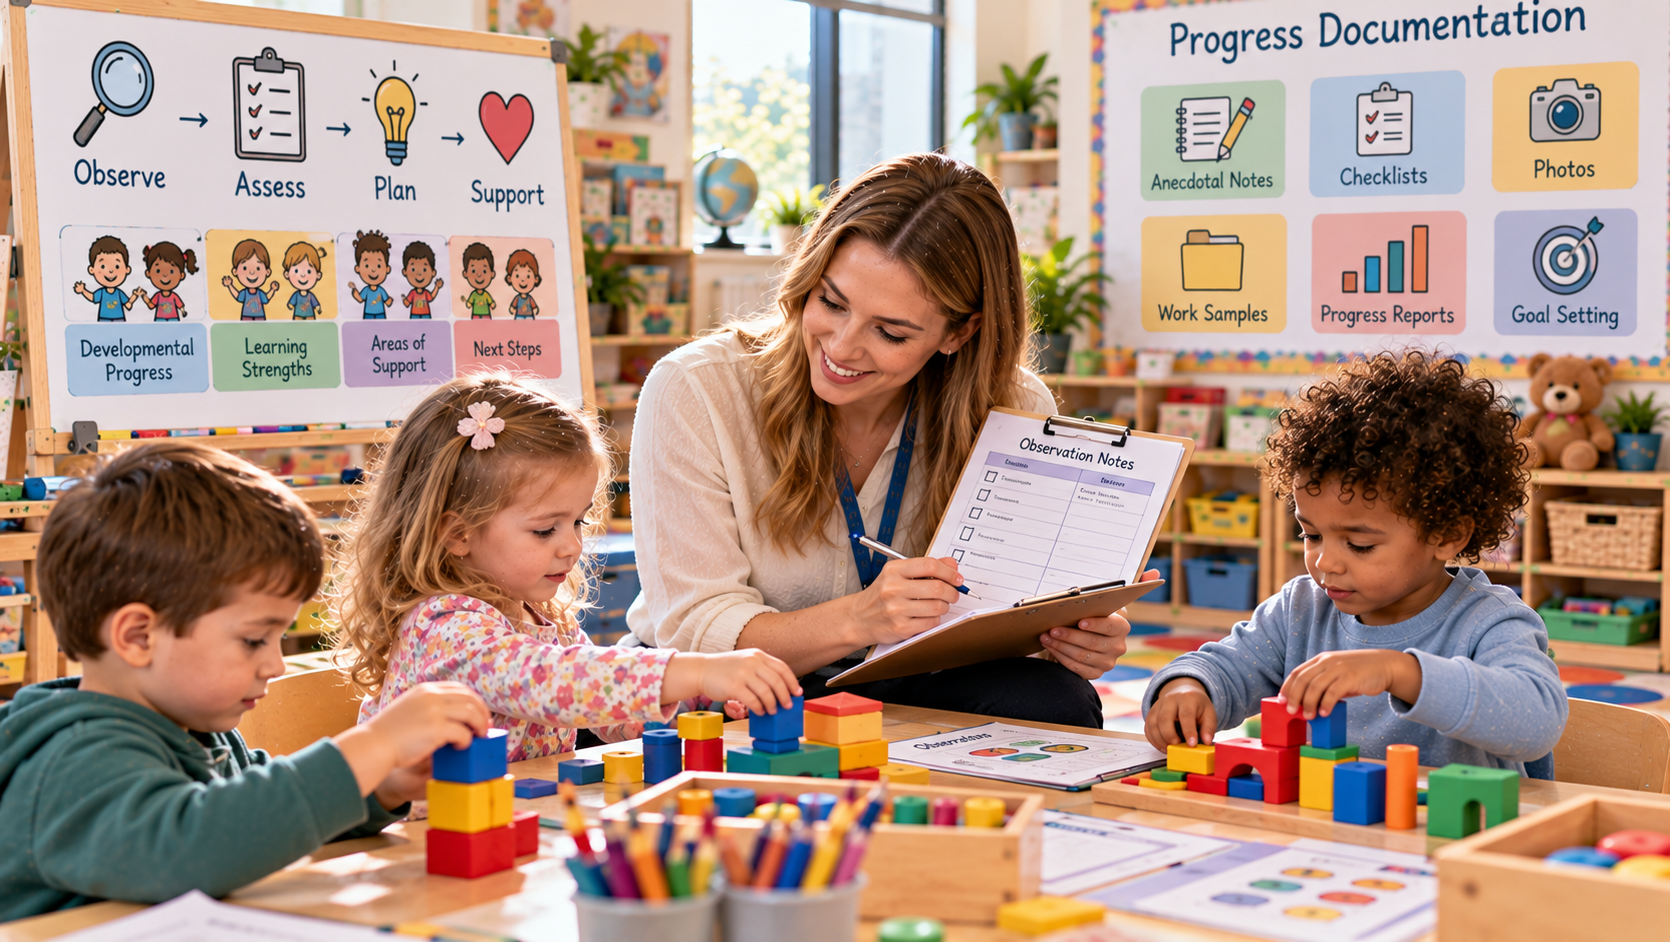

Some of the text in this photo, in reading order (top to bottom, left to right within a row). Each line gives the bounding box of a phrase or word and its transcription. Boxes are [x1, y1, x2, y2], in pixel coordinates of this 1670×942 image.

[1170, 0, 1586, 65] Progress Documentation
[73, 158, 166, 189] Observe
[1150, 170, 1274, 191] Anecdotal Notes
[1340, 165, 1428, 186] Checklists
[1534, 158, 1596, 179] Photos
[234, 170, 306, 199] Assess
[374, 175, 417, 201] Plan
[471, 179, 545, 213] Support
[1157, 303, 1268, 328] Work Samples
[1321, 304, 1455, 329] Progress Reports
[1511, 304, 1619, 330] Goal Setting
[80, 337, 194, 363] Developmental
[243, 337, 308, 359] Learning
[371, 333, 426, 352] Areas of
[473, 339, 542, 361] Next Steps
[105, 362, 173, 387] Progress
[242, 359, 313, 383] Strengths
[372, 356, 427, 378] Support
[1019, 437, 1135, 471] Observation Notes
